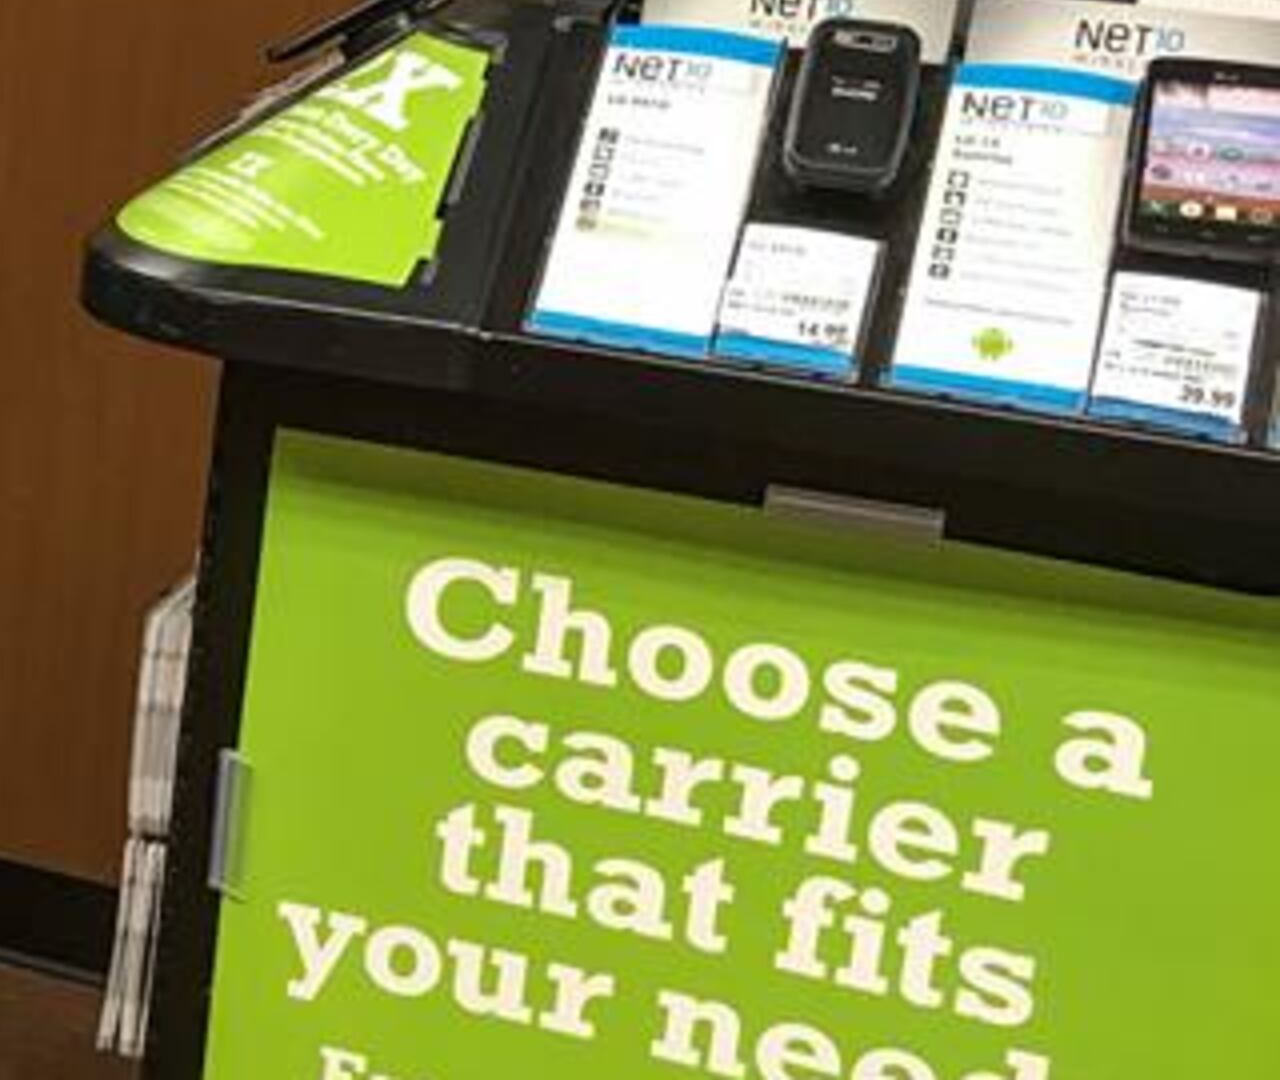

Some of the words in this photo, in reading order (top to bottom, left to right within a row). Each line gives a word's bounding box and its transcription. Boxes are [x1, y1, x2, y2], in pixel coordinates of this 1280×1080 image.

[403, 557, 1003, 764] Choose
[1052, 706, 1156, 800] a
[464, 713, 1050, 903] carrier
[276, 900, 618, 1041] your
[434, 802, 738, 956] that
[774, 874, 1038, 1028] fits
